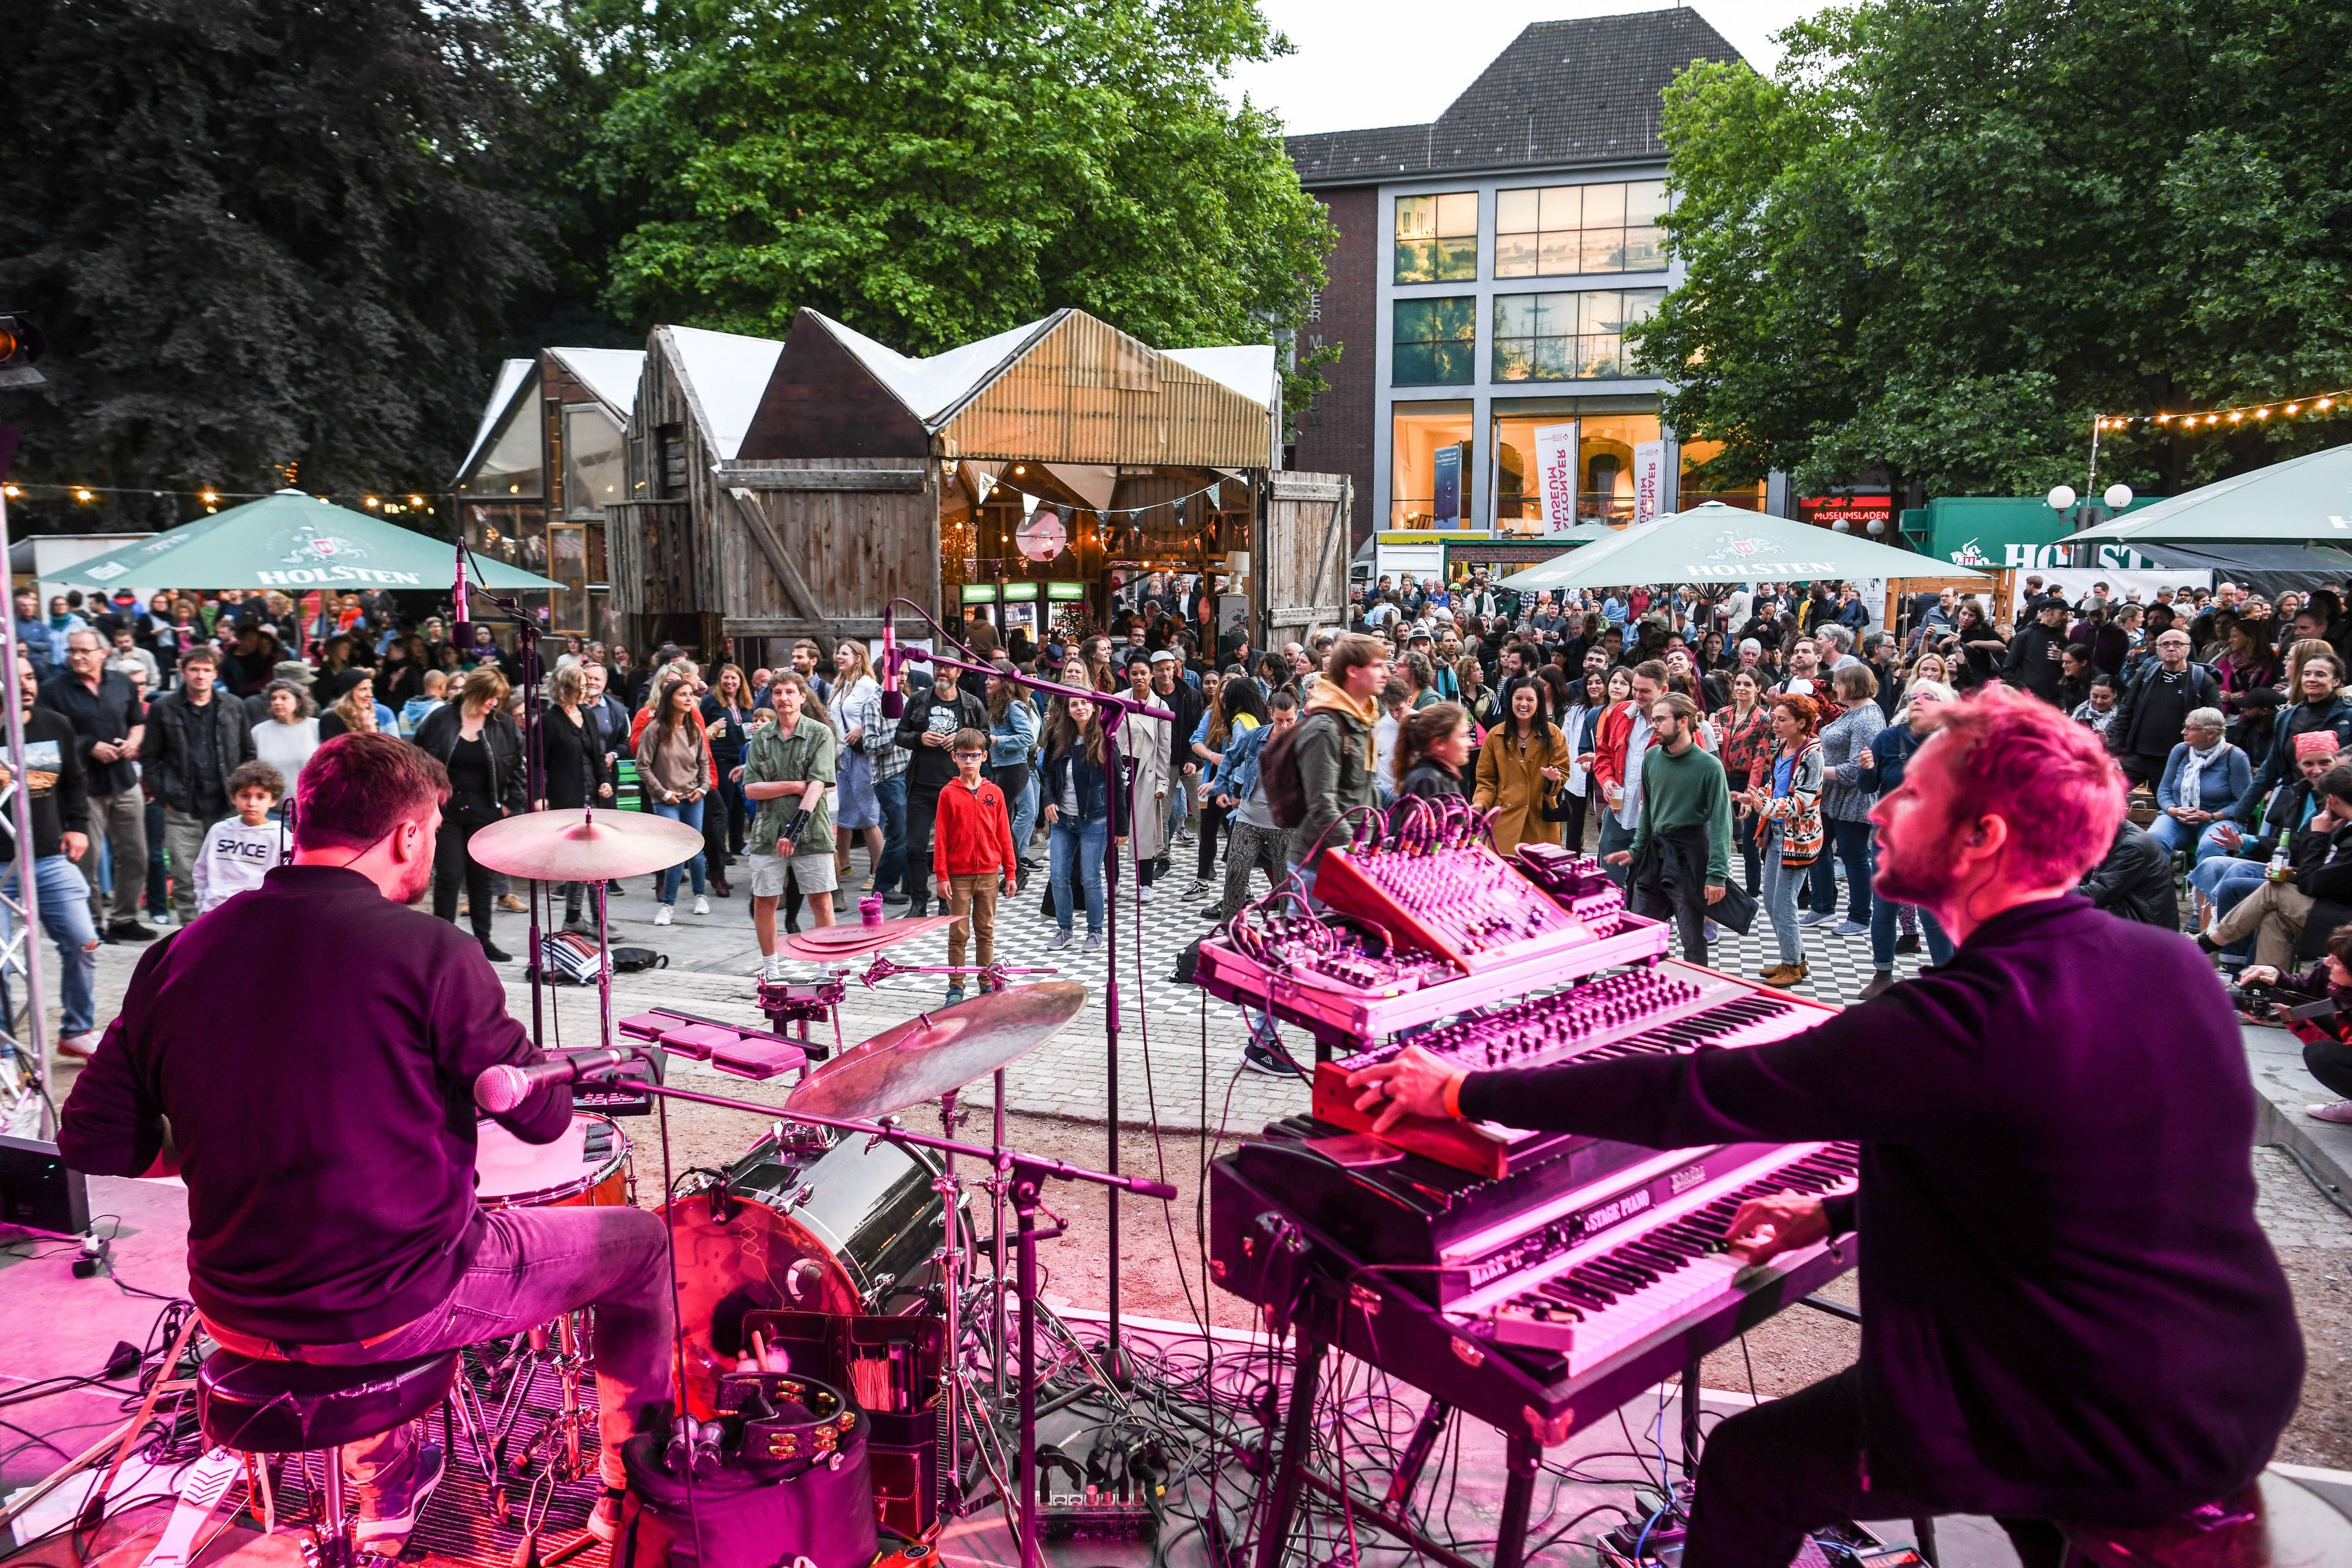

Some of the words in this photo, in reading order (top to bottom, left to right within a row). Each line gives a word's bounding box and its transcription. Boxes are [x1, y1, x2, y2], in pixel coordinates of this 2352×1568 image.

[1814, 511, 1889, 519] MUSEUMSLADEN
[256, 565, 421, 585] HOLSTEN
[1686, 562, 1836, 576] HOLSTEN
[217, 839, 266, 858] SPACE
[1588, 1203, 1621, 1231] STAGE
[1619, 1189, 1650, 1216] PIANO
